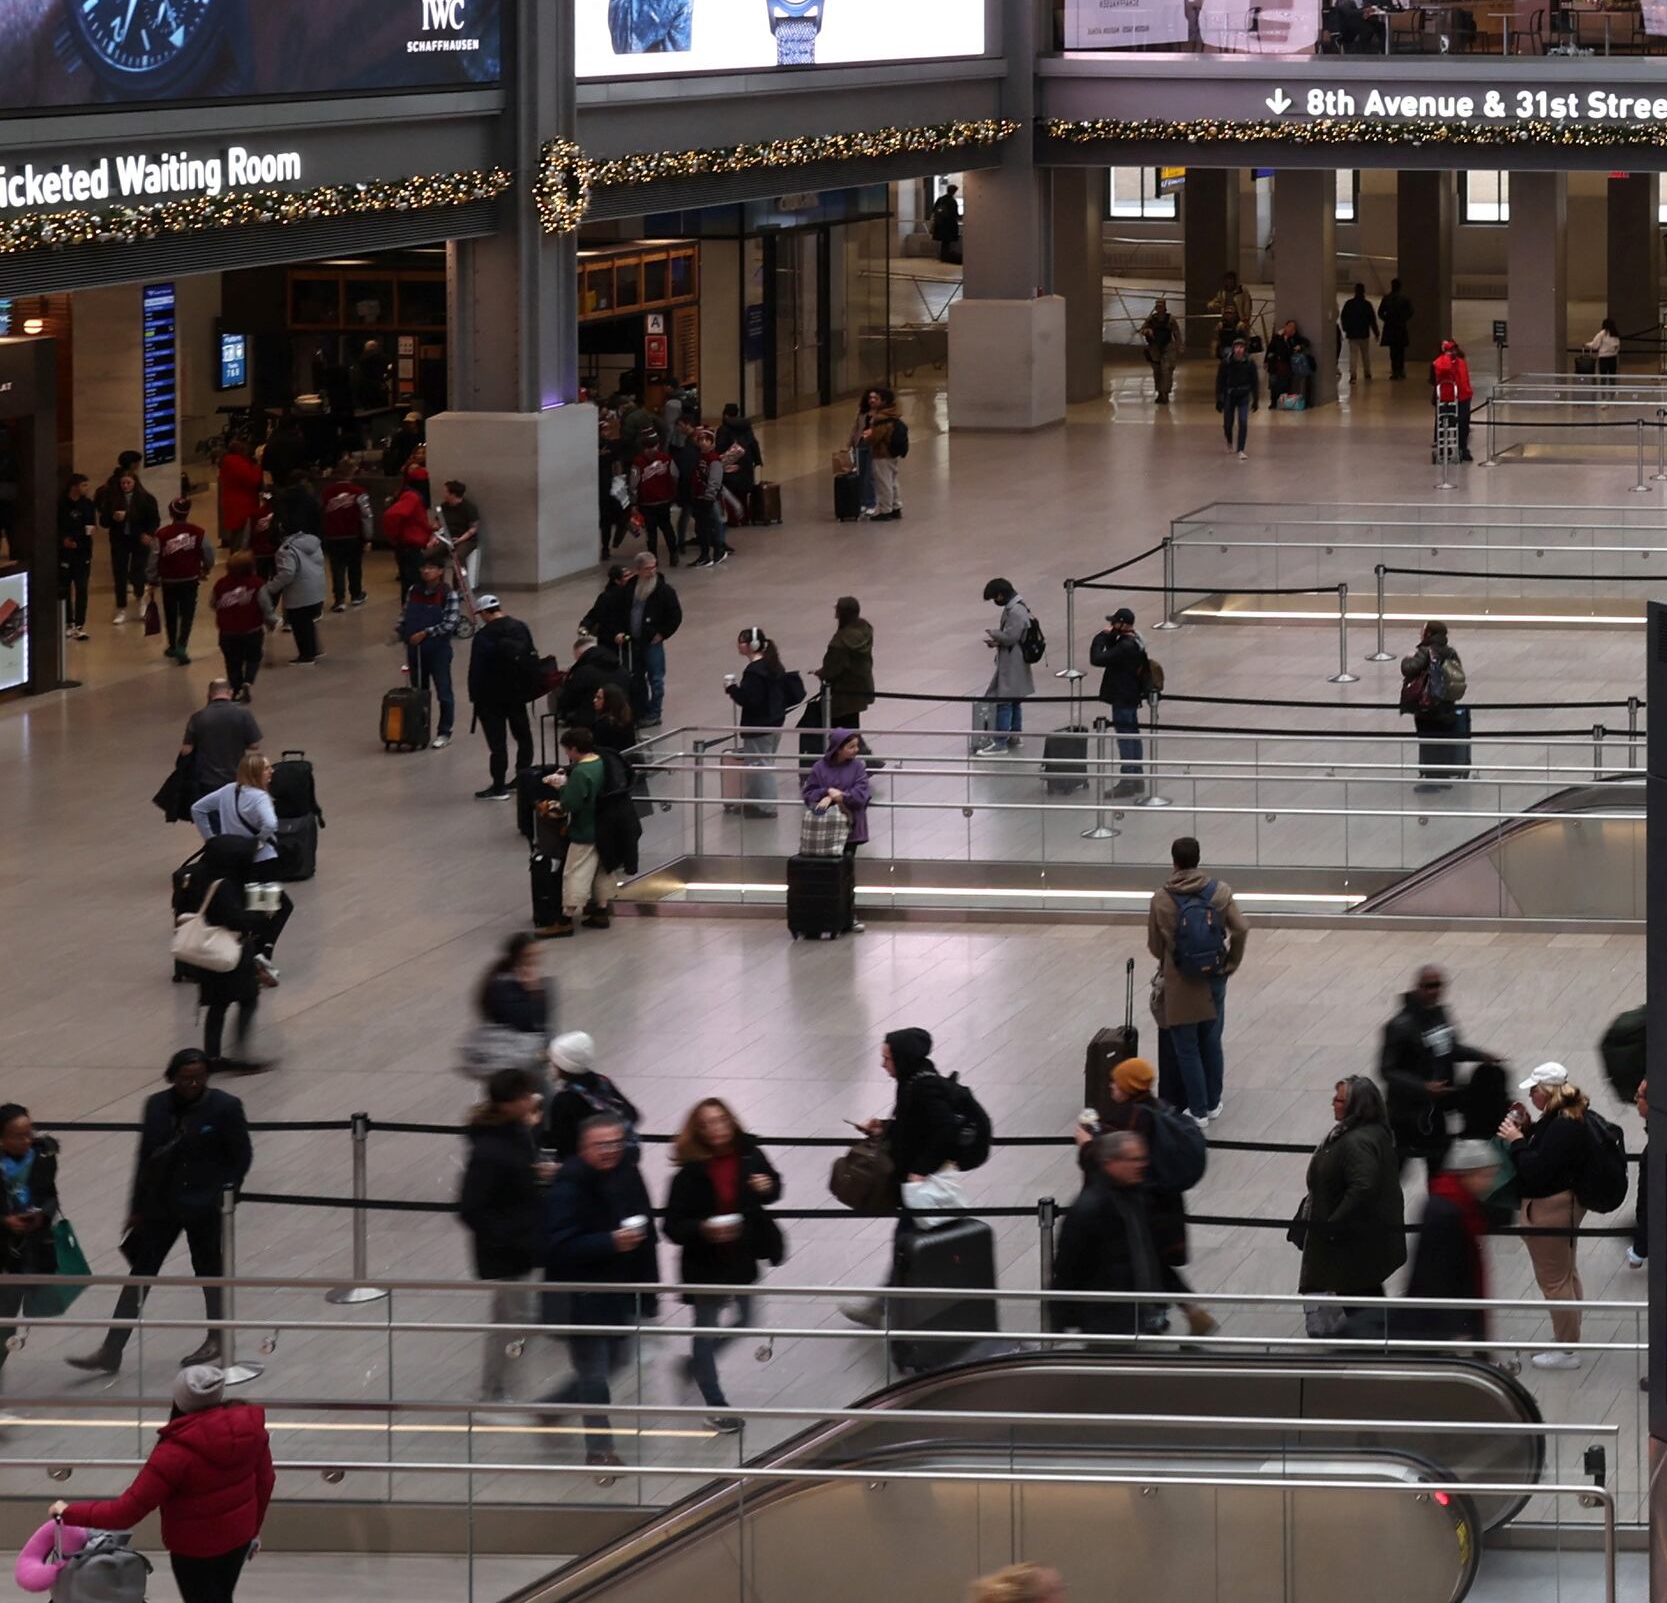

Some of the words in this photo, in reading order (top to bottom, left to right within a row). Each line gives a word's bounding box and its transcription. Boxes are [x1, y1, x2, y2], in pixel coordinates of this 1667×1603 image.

[407, 39, 480, 53] SCHAFFHAUSEN
[1305, 88, 1355, 117] 8th
[1364, 88, 1474, 117] Avenue
[1483, 88, 1506, 117] &
[1515, 88, 1580, 118] 31st
[116, 151, 221, 196] Waiting
[227, 146, 301, 187] Room
[651, 316, 661, 329] A
